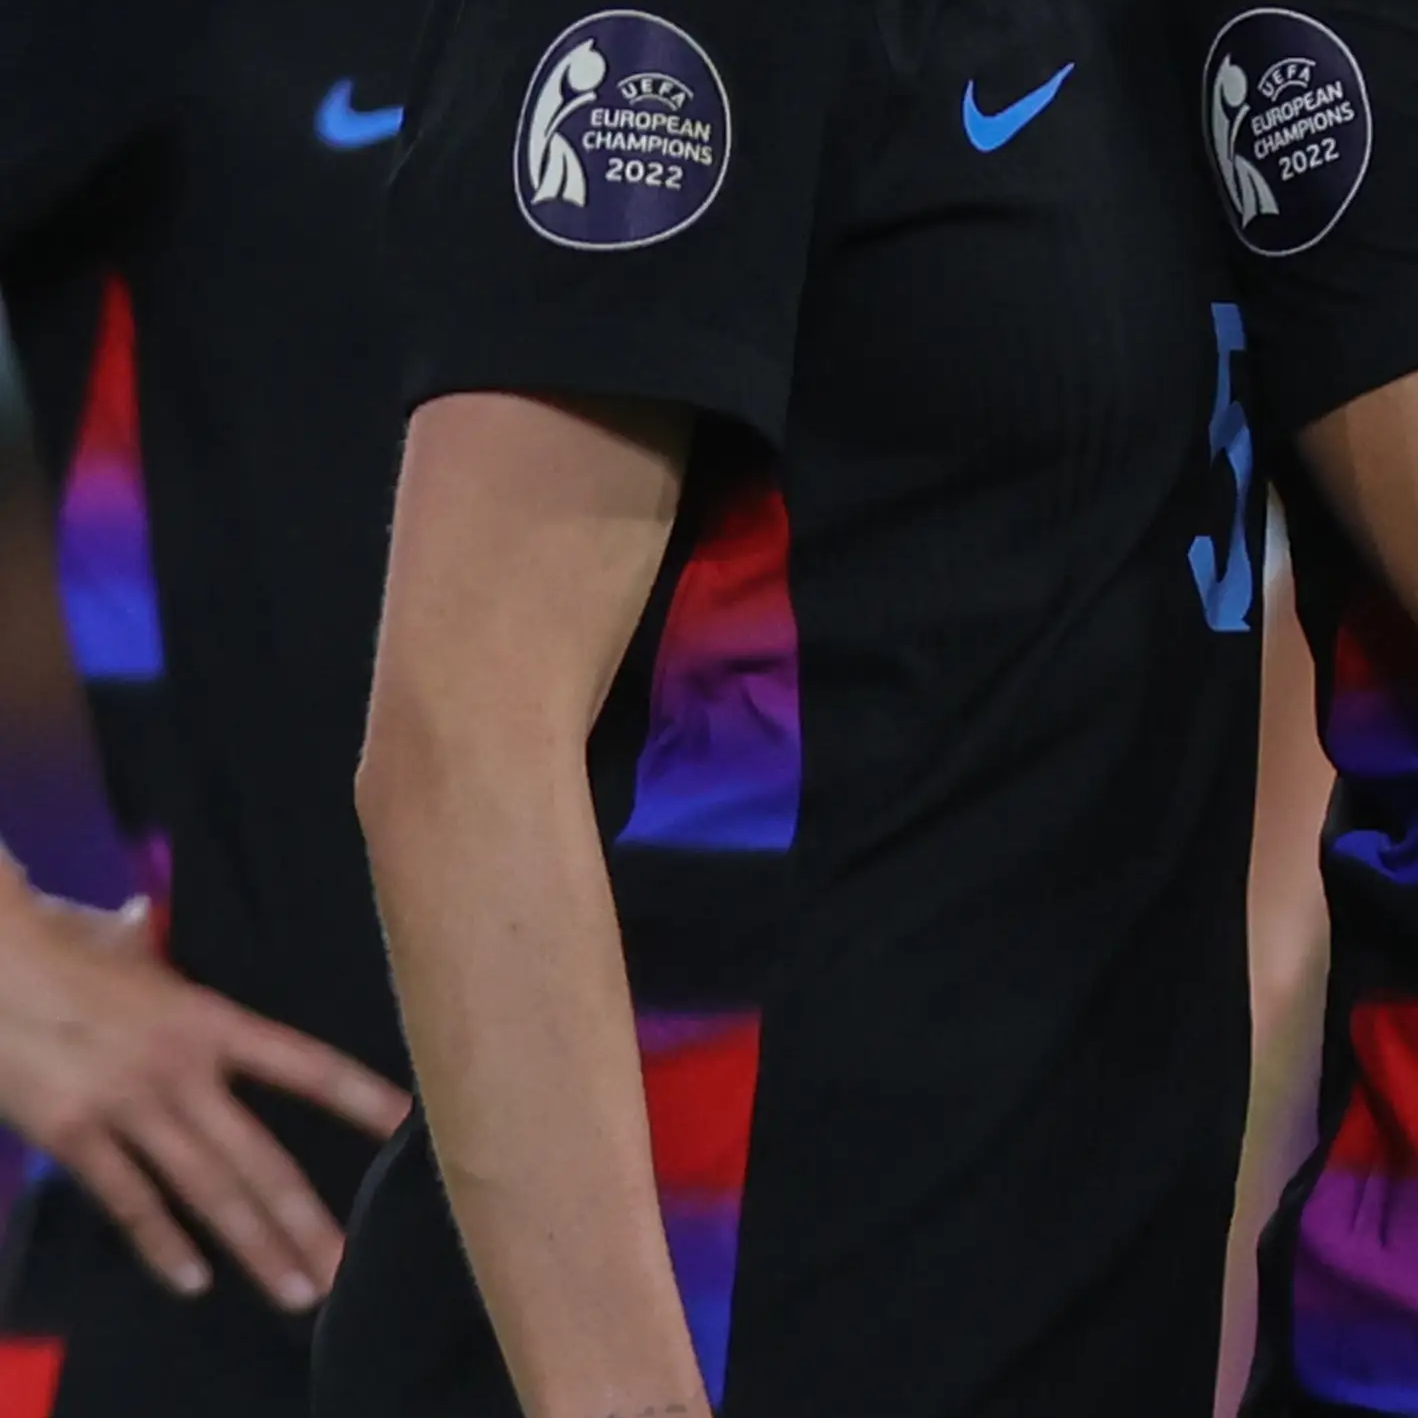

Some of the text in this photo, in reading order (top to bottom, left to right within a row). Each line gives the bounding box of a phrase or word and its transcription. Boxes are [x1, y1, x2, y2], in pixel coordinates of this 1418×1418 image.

[620, 78, 688, 109] UEFA
[1260, 63, 1311, 98] UEFA
[590, 107, 711, 142] EUROPEAN
[1251, 81, 1344, 136] EUROPEAN
[1253, 100, 1355, 160] CHAMPIONS
[582, 130, 713, 166] CHAMPIONS
[1278, 137, 1340, 182] 2022
[605, 157, 683, 191] 2022
